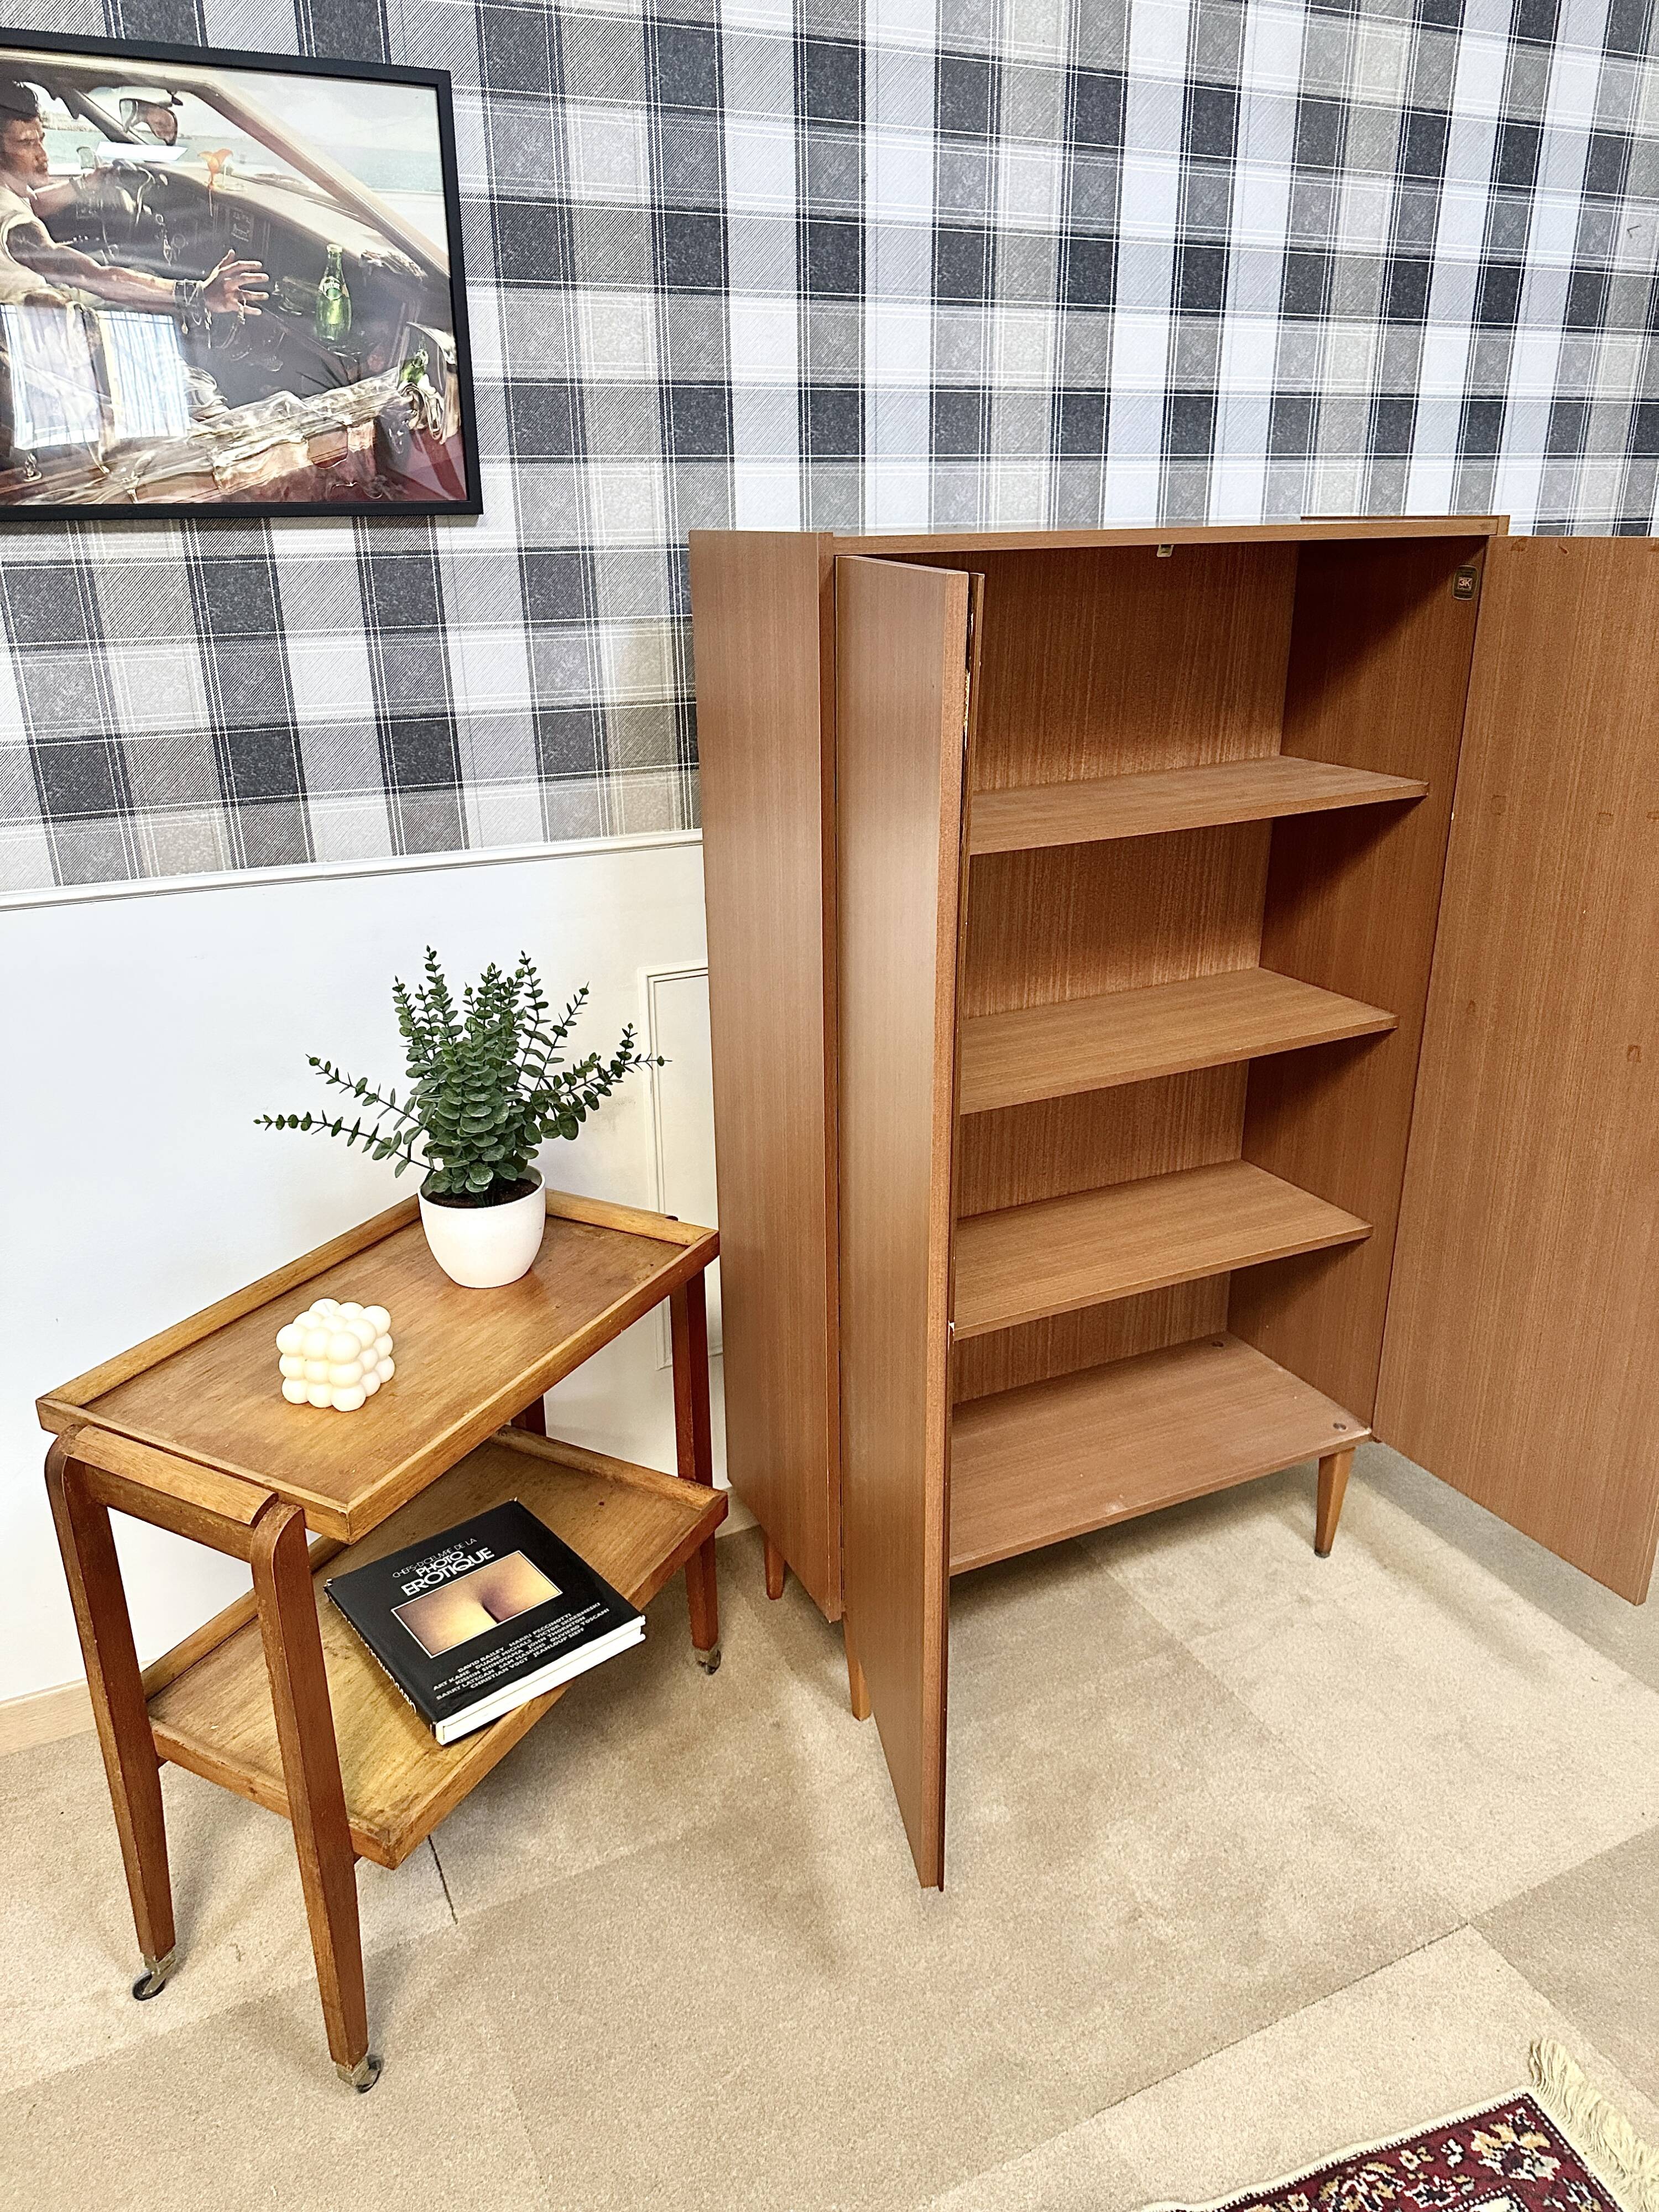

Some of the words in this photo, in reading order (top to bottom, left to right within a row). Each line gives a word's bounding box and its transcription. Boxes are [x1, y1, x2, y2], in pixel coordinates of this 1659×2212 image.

[401, 1547, 495, 1596] EROTIQUE
[415, 1551, 464, 1577] PHOTO
[453, 1542, 466, 1551] DE
[433, 1681, 447, 1691] ART
[448, 1670, 470, 1683] KANE
[475, 1655, 501, 1670] DUANE
[501, 1639, 532, 1656] MICHALS
[535, 1624, 561, 1639] VICTOR
[436, 1686, 461, 1700] BARRY
[461, 1669, 495, 1688] LATEGAN
[498, 1659, 514, 1669] SAM
[515, 1643, 546, 1661] HASKINS
[550, 1625, 580, 1642] OLIVIERO
[580, 1608, 609, 1626] TOSCANI
[455, 1670, 481, 1685] KISHIN
[481, 1649, 524, 1672] SHINOYAMA
[527, 1637, 546, 1649] JOHN
[546, 1616, 586, 1637] THORNTON
[457, 1660, 479, 1673] DAVID
[480, 1647, 504, 1661] BAILEY
[509, 1634, 532, 1647] HARRI
[532, 1613, 572, 1635] PECCINOTTI
[470, 1667, 509, 1688] CHRISTIAN
[509, 1657, 528, 1668] VOGT
[533, 1636, 568, 1658] JEANLOUP
[568, 1627, 584, 1639] SIEFF
